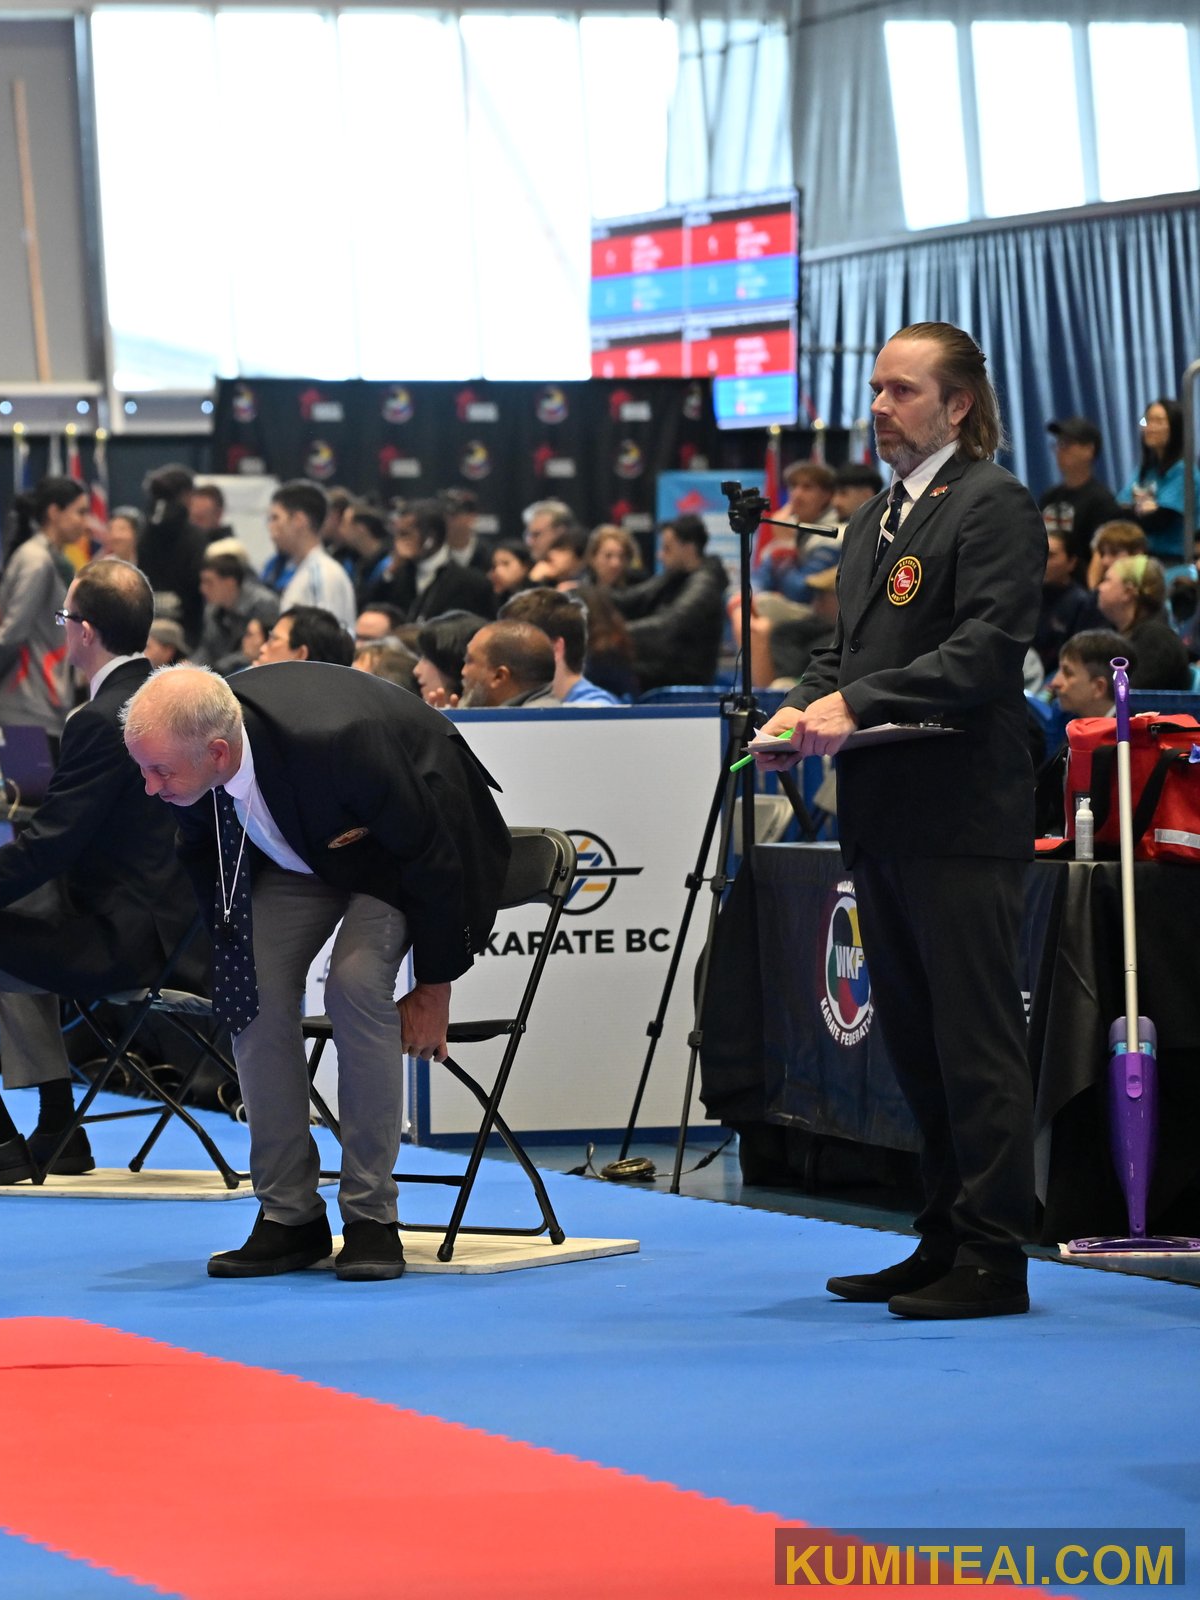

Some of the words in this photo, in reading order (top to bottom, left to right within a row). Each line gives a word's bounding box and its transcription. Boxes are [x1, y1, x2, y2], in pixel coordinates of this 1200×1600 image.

[478, 928, 616, 957] KARATE
[625, 927, 671, 953] BC
[834, 944, 864, 980] WKF
[820, 996, 841, 1041] KARATE
